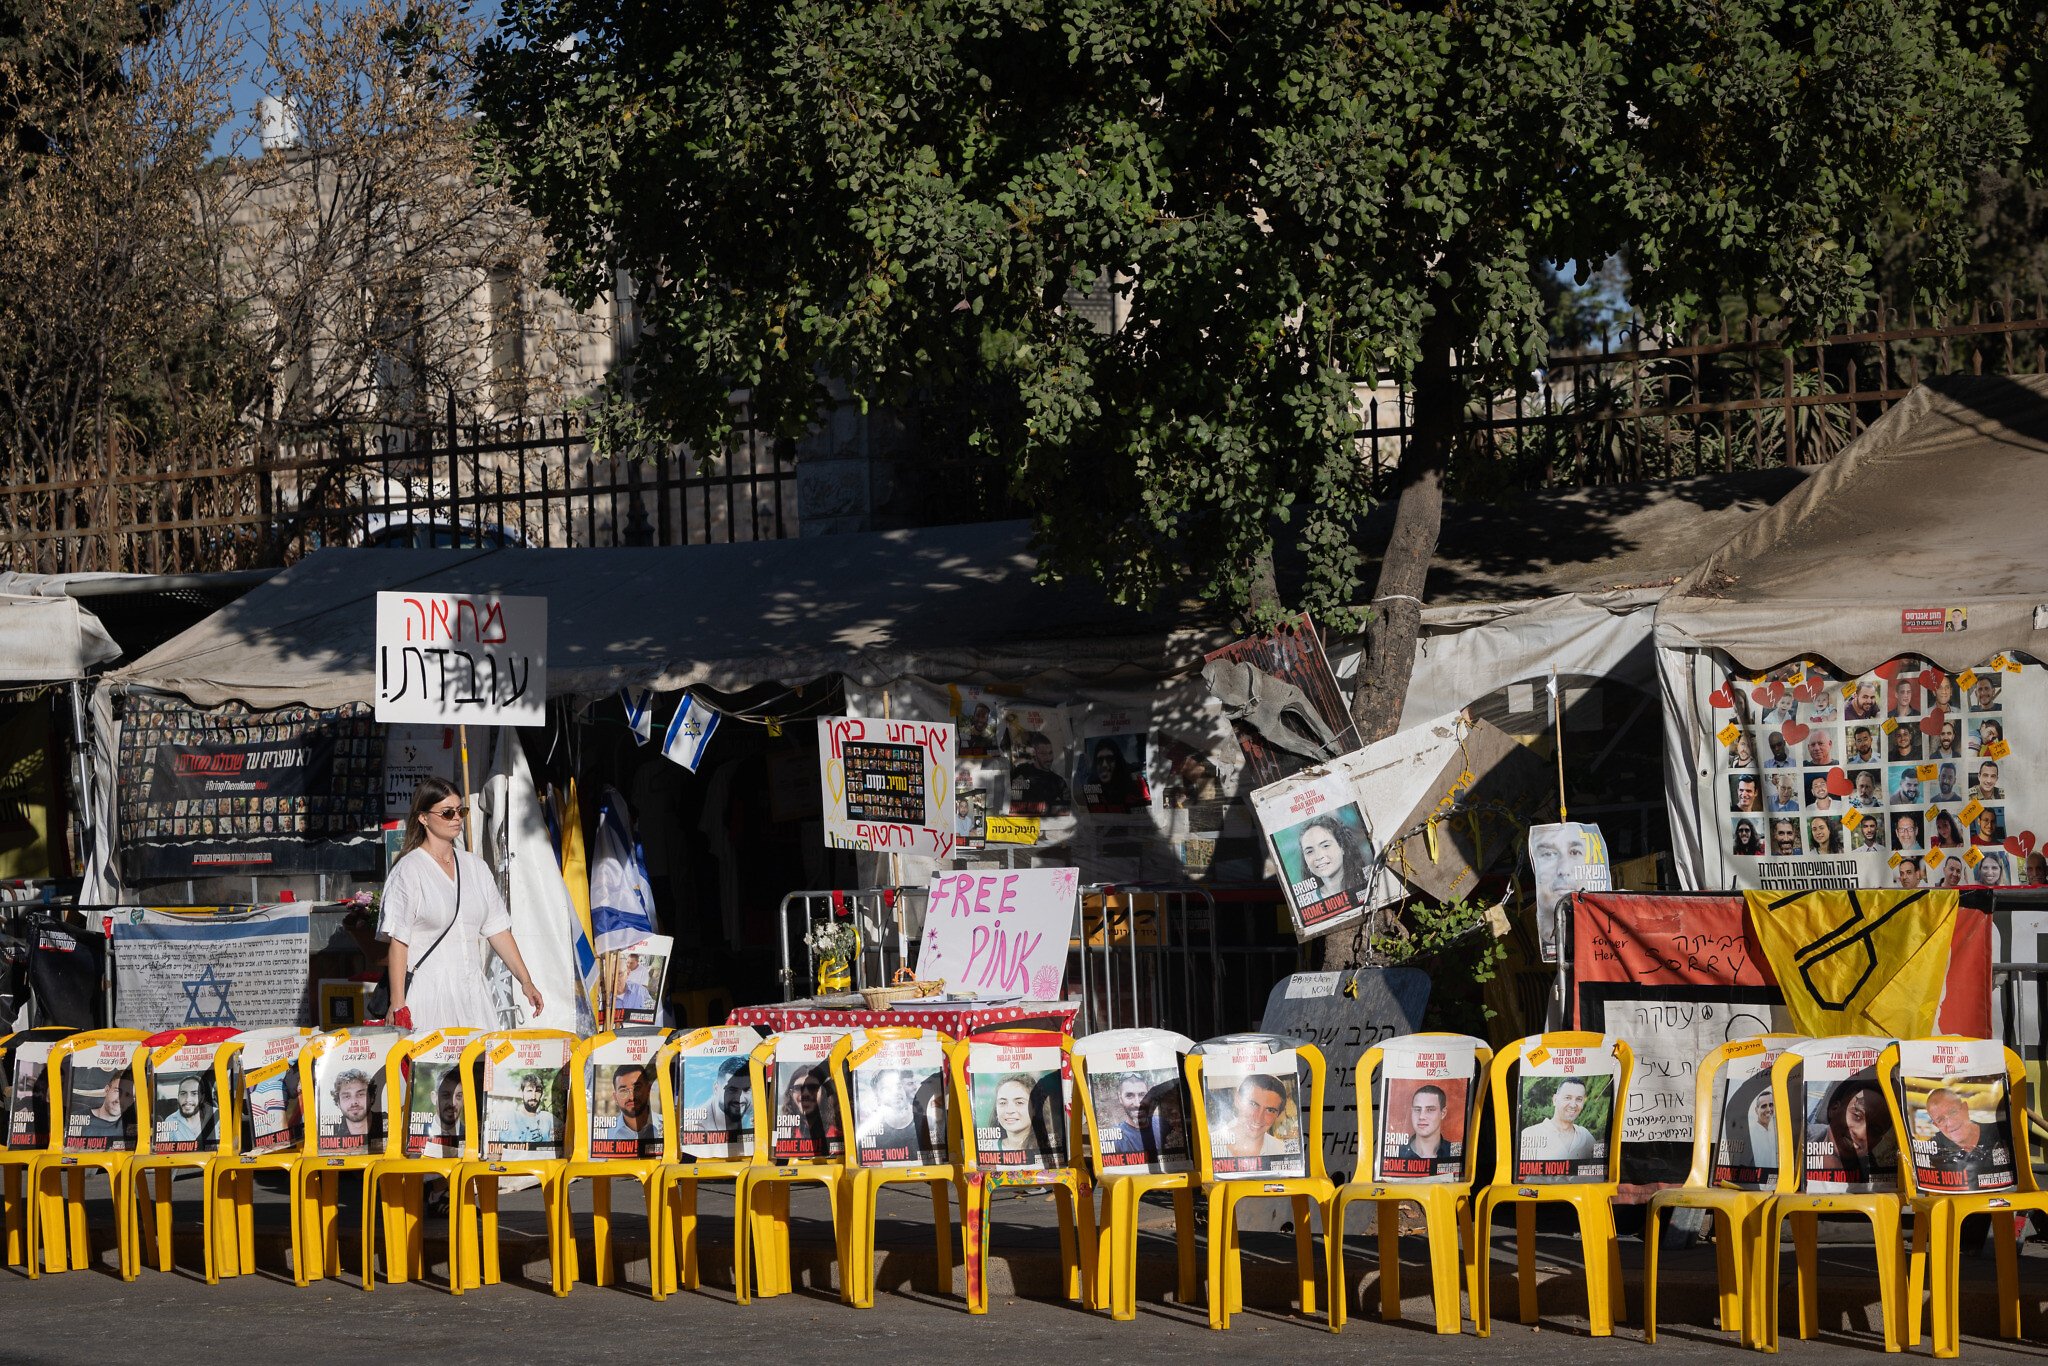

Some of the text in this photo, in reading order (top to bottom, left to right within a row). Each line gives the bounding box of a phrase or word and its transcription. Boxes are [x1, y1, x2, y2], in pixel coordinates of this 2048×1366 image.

[403, 598, 507, 643] מחאה
[382, 645, 529, 707] עובדת!
[826, 720, 947, 766] אנחנו כאן
[246, 752, 260, 770] עד
[261, 748, 296, 769] עוצרים
[205, 780, 268, 792] #BringThemHomeNow
[992, 826, 1036, 835] תינוק בעזה
[857, 824, 953, 858] עד החטוף
[1579, 832, 1605, 864] אל
[1574, 864, 1607, 879] תשאירו
[1758, 860, 1857, 877] מטה המשפחות להחזרת
[1292, 877, 1318, 896] BRING
[930, 874, 1019, 918] FREE
[1296, 894, 1314, 908] HER
[1301, 904, 1326, 921] HOME
[1327, 892, 1350, 911] NOW!
[1639, 948, 1745, 984] SORRY
[1635, 1006, 1694, 1033] עסקה
[1010, 1062, 1020, 1070] (27)
[1932, 1056, 1946, 1064] MENY
[1564, 1065, 1574, 1073] (53)
[1638, 1057, 1692, 1085] תציל
[1629, 1092, 1684, 1113] אותם
[14, 1112, 34, 1122] BRING
[70, 1115, 90, 1125] BRING
[320, 1115, 342, 1125] BRING
[411, 1112, 433, 1123] BRING
[684, 1108, 707, 1120] BRING
[156, 1121, 178, 1131] BRING
[594, 1116, 616, 1128] BRING
[684, 1121, 699, 1130] HIM
[776, 1115, 800, 1126] BRING
[13, 1123, 26, 1132] HIM
[68, 1126, 82, 1136] HIM
[320, 1125, 334, 1136] HIM
[409, 1124, 424, 1135] HIM
[776, 1127, 792, 1138] HIM
[977, 1127, 1001, 1139] BRING
[11, 1135, 30, 1144] HOME
[156, 1132, 170, 1142] HIM
[593, 1129, 608, 1139] HIM
[684, 1132, 705, 1144] HOME
[1098, 1128, 1123, 1141] BRING
[1211, 1133, 1236, 1145] BRING
[1385, 1133, 1409, 1146] BRING
[67, 1138, 86, 1148] HOME
[87, 1137, 107, 1148] NOW!
[155, 1141, 198, 1151] HOME NOW!
[256, 1134, 275, 1147] HOME
[320, 1135, 364, 1148] HOME NOW!
[592, 1140, 638, 1153] HOME NOW!
[776, 1140, 798, 1152] HOME
[861, 1137, 876, 1148] HIM
[1521, 1136, 1548, 1148] BRING
[1720, 1139, 1744, 1153] BRING
[1100, 1141, 1116, 1153] HIM
[1384, 1147, 1400, 1157] HIM
[1807, 1142, 1834, 1155] BRING
[1912, 1139, 1938, 1155] BRING
[862, 1147, 909, 1161] HOME NOW!
[979, 1150, 1026, 1164] HOME NOW!
[1102, 1154, 1124, 1166] HOME
[1213, 1159, 1235, 1172] HOME
[1238, 1157, 1262, 1171] NOW!
[1383, 1159, 1430, 1172] HOME NOW!
[1807, 1156, 1824, 1169] HIM
[1915, 1154, 1930, 1168] HIM
[1519, 1160, 1569, 1175] HOME NOW!
[1716, 1168, 1761, 1181] HOME NOW!
[1807, 1171, 1832, 1181] HOME
[1918, 1169, 1968, 1185] HOME NOW!
